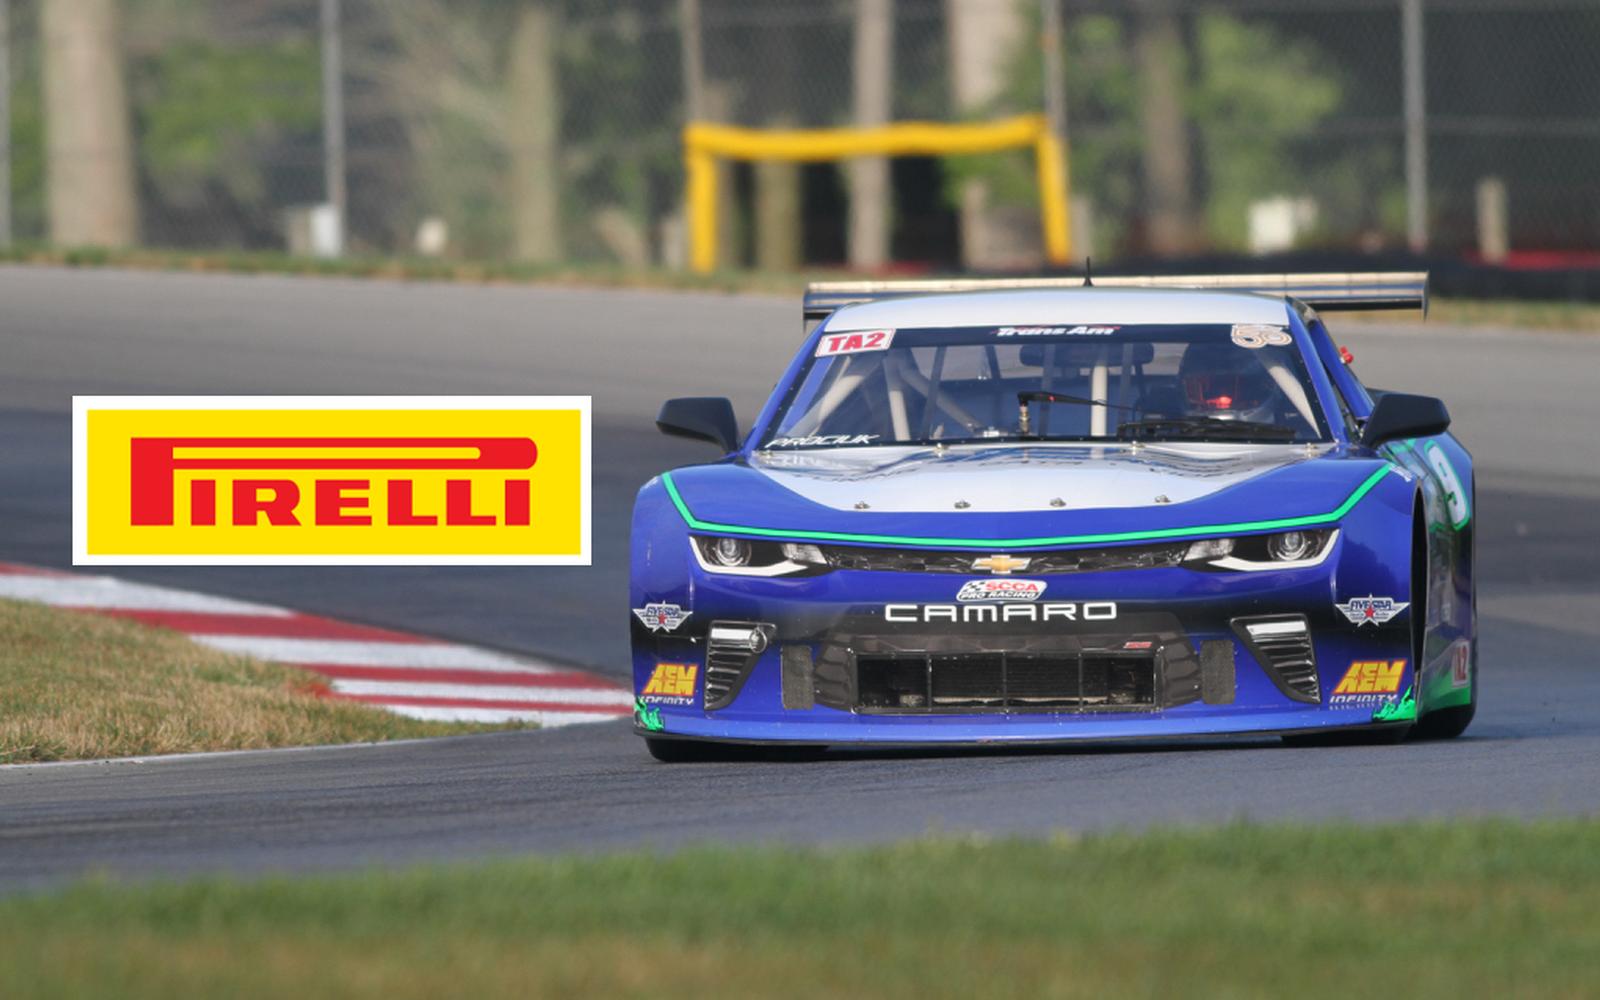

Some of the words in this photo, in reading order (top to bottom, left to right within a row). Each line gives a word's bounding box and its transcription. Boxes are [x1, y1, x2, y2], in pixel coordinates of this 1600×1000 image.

[828, 331, 886, 353] TA2
[764, 433, 880, 448] PROCIUK
[959, 590, 986, 600] PRO
[988, 590, 1037, 599] RACING
[986, 581, 1039, 592] SCCA
[884, 602, 1118, 623] CAMARO
[642, 663, 698, 695] AEM
[1333, 659, 1406, 694] AEM
